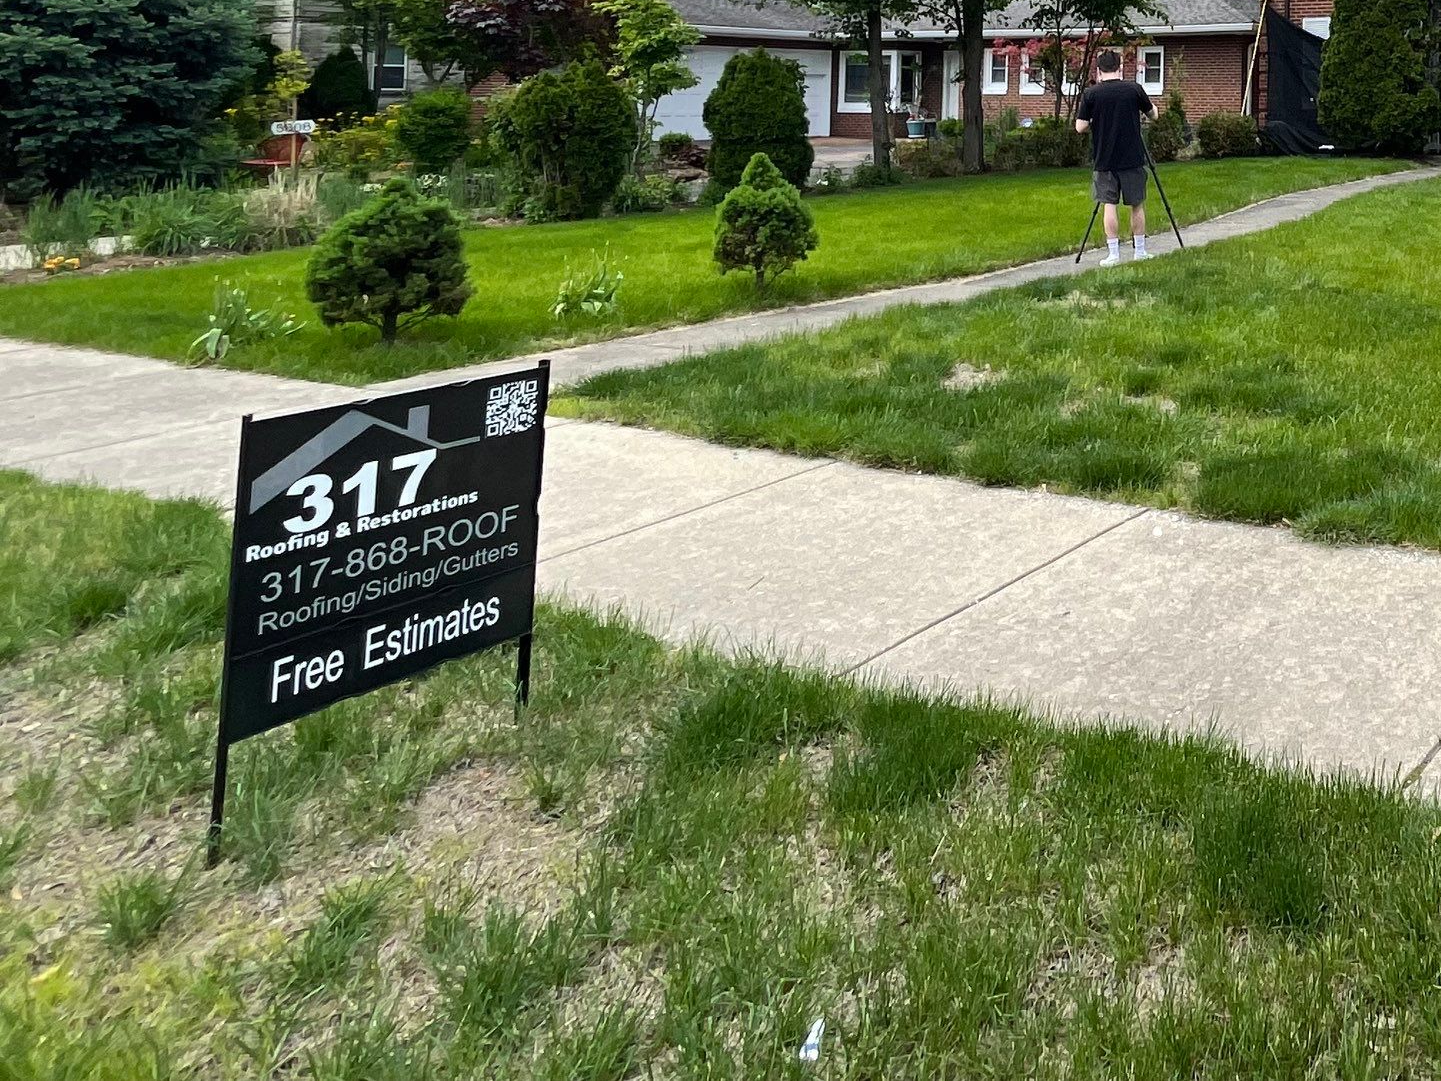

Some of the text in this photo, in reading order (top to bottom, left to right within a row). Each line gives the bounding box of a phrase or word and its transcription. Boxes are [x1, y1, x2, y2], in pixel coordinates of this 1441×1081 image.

[245, 489, 479, 563] Roofing & Restorations
[282, 448, 438, 533] 317
[258, 540, 519, 635] Roofing/Siding/Gutters
[260, 504, 520, 603] 317-868-ROOF
[270, 595, 500, 703] Free Estimates
